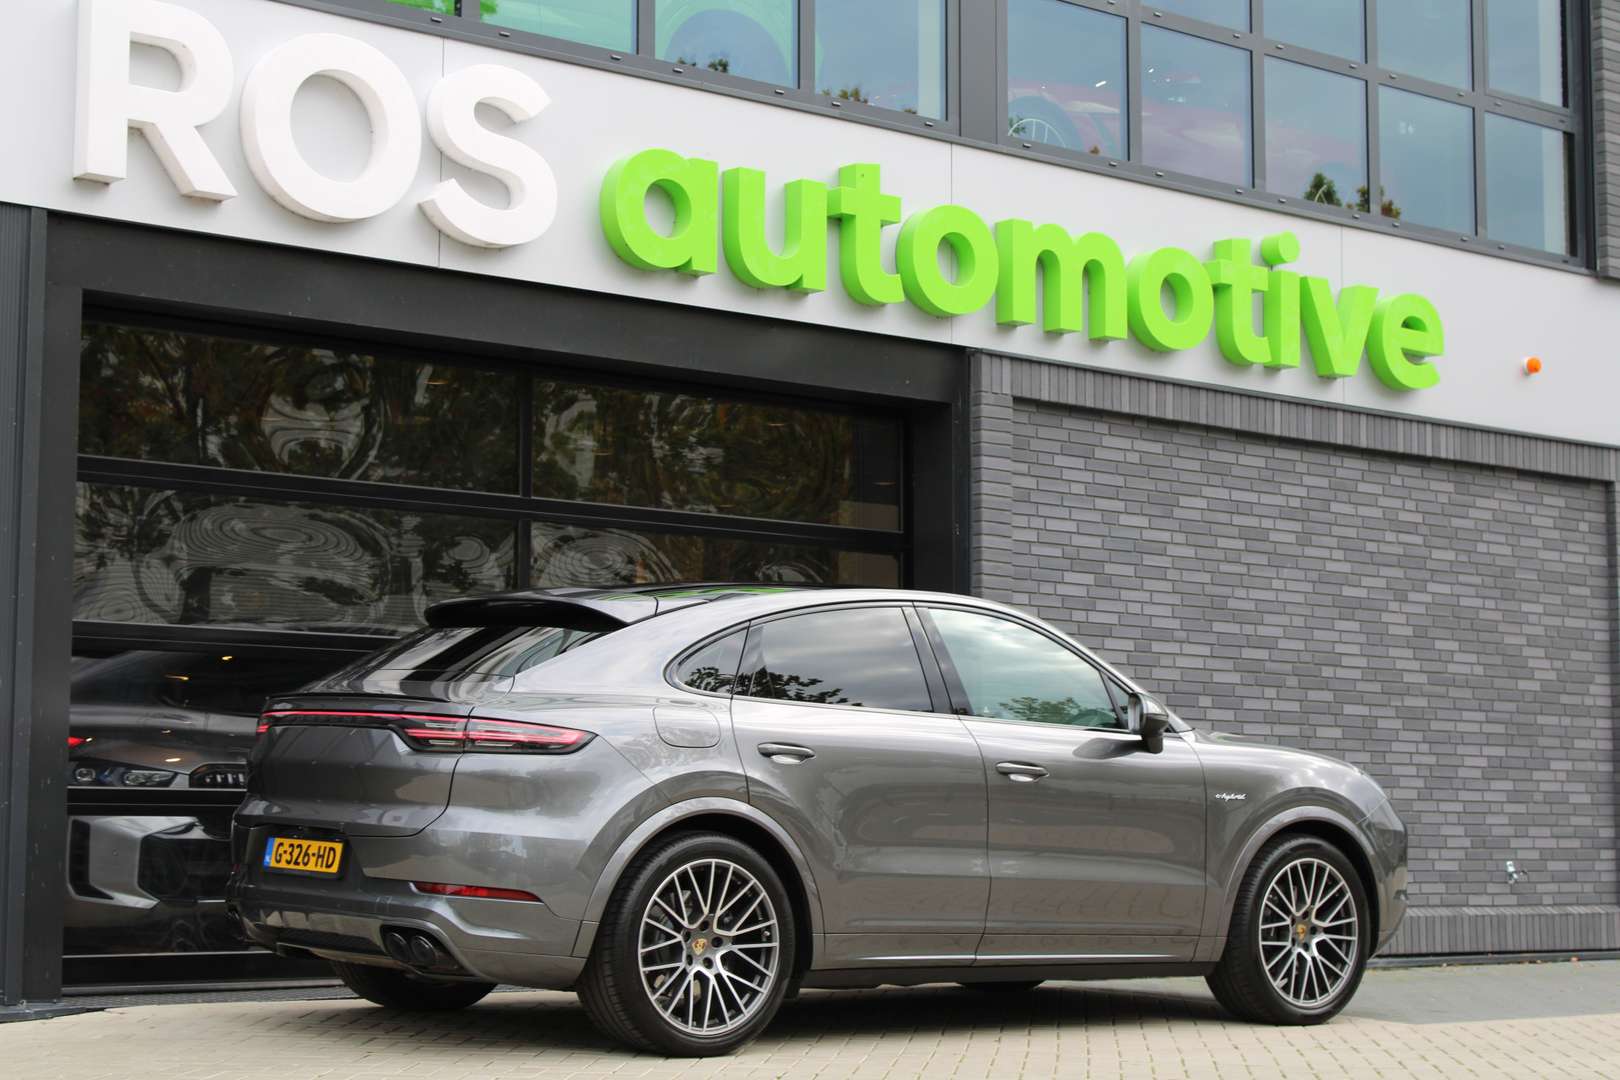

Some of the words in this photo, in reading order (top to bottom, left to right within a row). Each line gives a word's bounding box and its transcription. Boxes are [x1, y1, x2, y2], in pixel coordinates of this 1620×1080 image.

[73, 0, 558, 248] ROS
[600, 147, 1444, 390] automotive
[274, 842, 337, 869] G-326-HD
